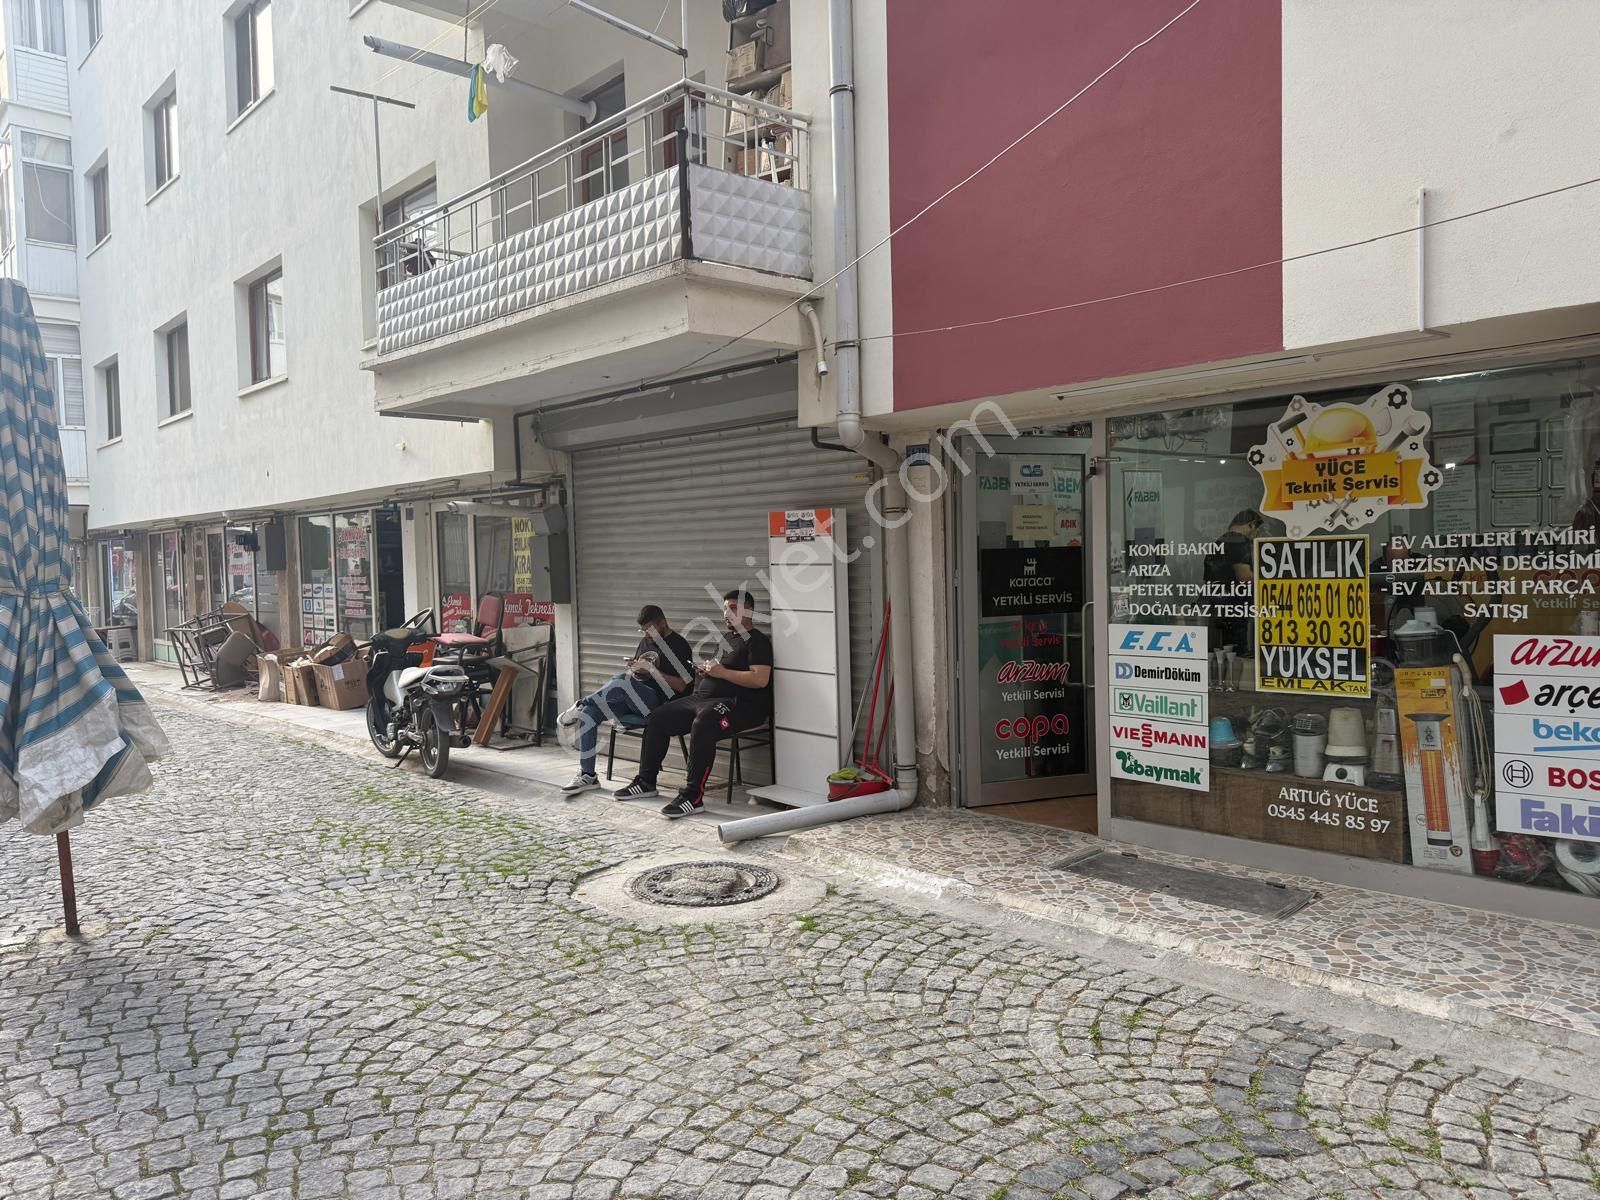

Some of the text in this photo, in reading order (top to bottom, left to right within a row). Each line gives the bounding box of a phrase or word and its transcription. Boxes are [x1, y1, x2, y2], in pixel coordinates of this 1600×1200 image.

[1316, 458, 1366, 477] YÜCE
[979, 475, 1011, 490] FABE
[1285, 475, 1399, 495] Teknik Servis
[1134, 491, 1160, 502] FABEM
[1391, 525, 1596, 550] EV ALETLERİ TAMİRİ
[1129, 541, 1225, 557] KOMBİ BAKIM
[1260, 540, 1365, 579] SATILIK
[1129, 564, 1171, 577] ARIZA
[1391, 549, 1600, 574] REZİSTANS DEĞİŞİMİ
[1129, 580, 1252, 597] PETEK TEMİZLİĞİ
[1391, 581, 1417, 596] EV
[1421, 576, 1516, 596] ALETLERİ
[1521, 579, 1596, 598] PARÇA
[504, 599, 522, 613] kmek
[992, 592, 1073, 606] YETKİLİ SERVİS
[1129, 601, 1279, 618] DOĞALGAZ TESİSAT
[1261, 583, 1364, 619] 0544 665 01 66
[1533, 597, 1577, 609] Yetkili
[1463, 603, 1529, 623] SATIŞI
[1120, 630, 1193, 653] E.C.A
[1261, 620, 1365, 647] 813 30 30
[997, 660, 1070, 684] arzum
[1134, 665, 1200, 682] DemirDöküm
[1260, 646, 1366, 682] YÜKSEL
[1002, 688, 1065, 702] Yetkili Servisi
[1135, 693, 1197, 718] Vaillant
[995, 714, 1069, 744] copa
[1113, 723, 1206, 749] VIESSMANN
[996, 742, 1070, 760] Yetkili Servisi
[1133, 759, 1201, 785] baymak
[1279, 787, 1379, 813] ARTUĞ YÜCE
[1267, 804, 1391, 833] 0545 445 85 97
